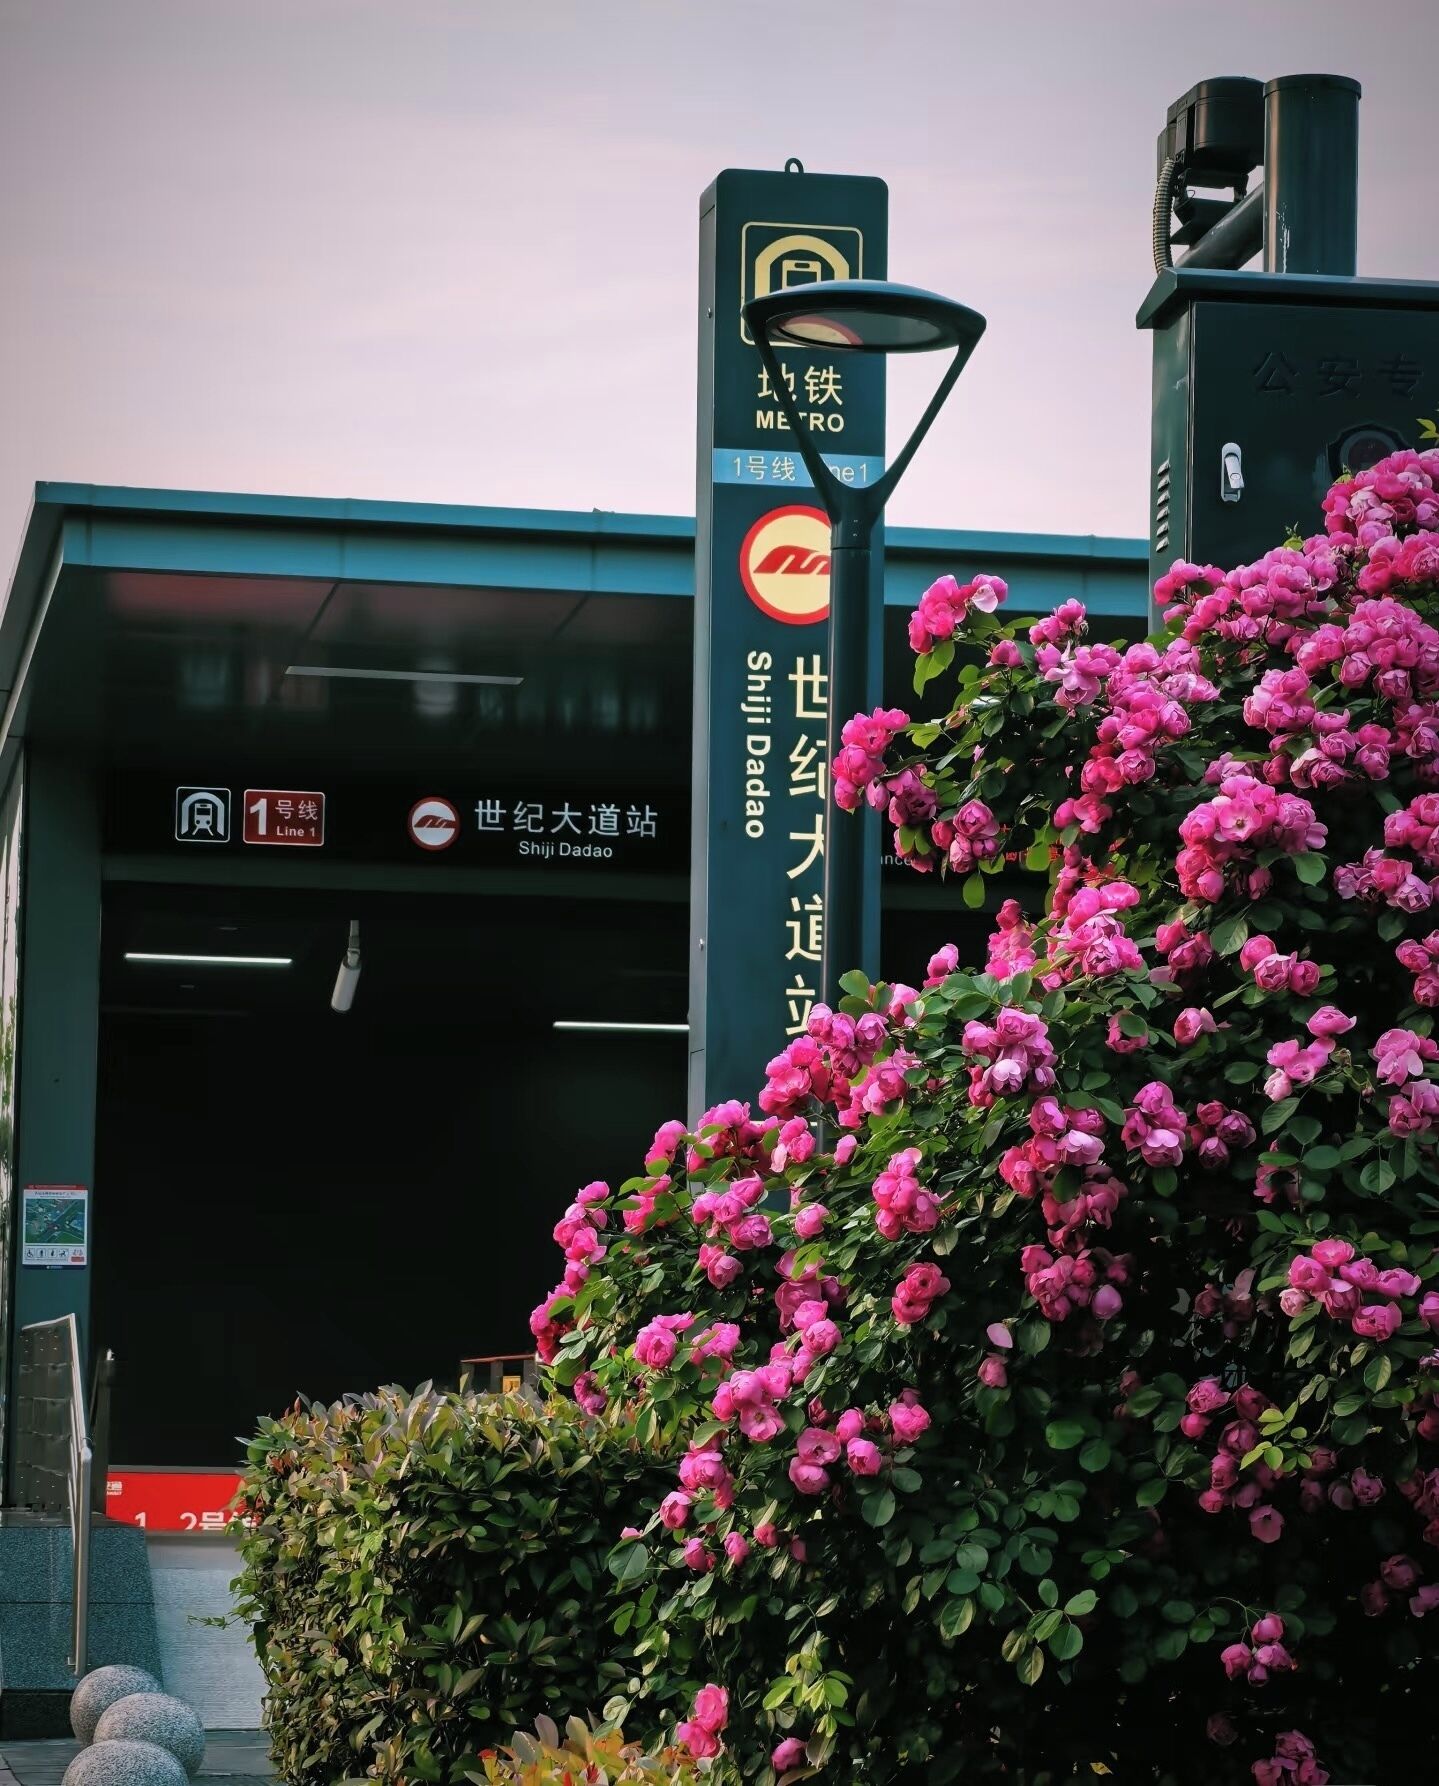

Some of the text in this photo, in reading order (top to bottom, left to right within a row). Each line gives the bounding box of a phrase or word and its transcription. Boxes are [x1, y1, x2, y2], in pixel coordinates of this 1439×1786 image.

[1253, 351, 1425, 400] 公安专
[733, 455, 796, 481] 1号线
[740, 651, 772, 839] Shiji Dadao
[276, 825, 316, 838] Line 1
[474, 799, 659, 838] 世纪大道站
[518, 840, 613, 859] Shiji Dadao
